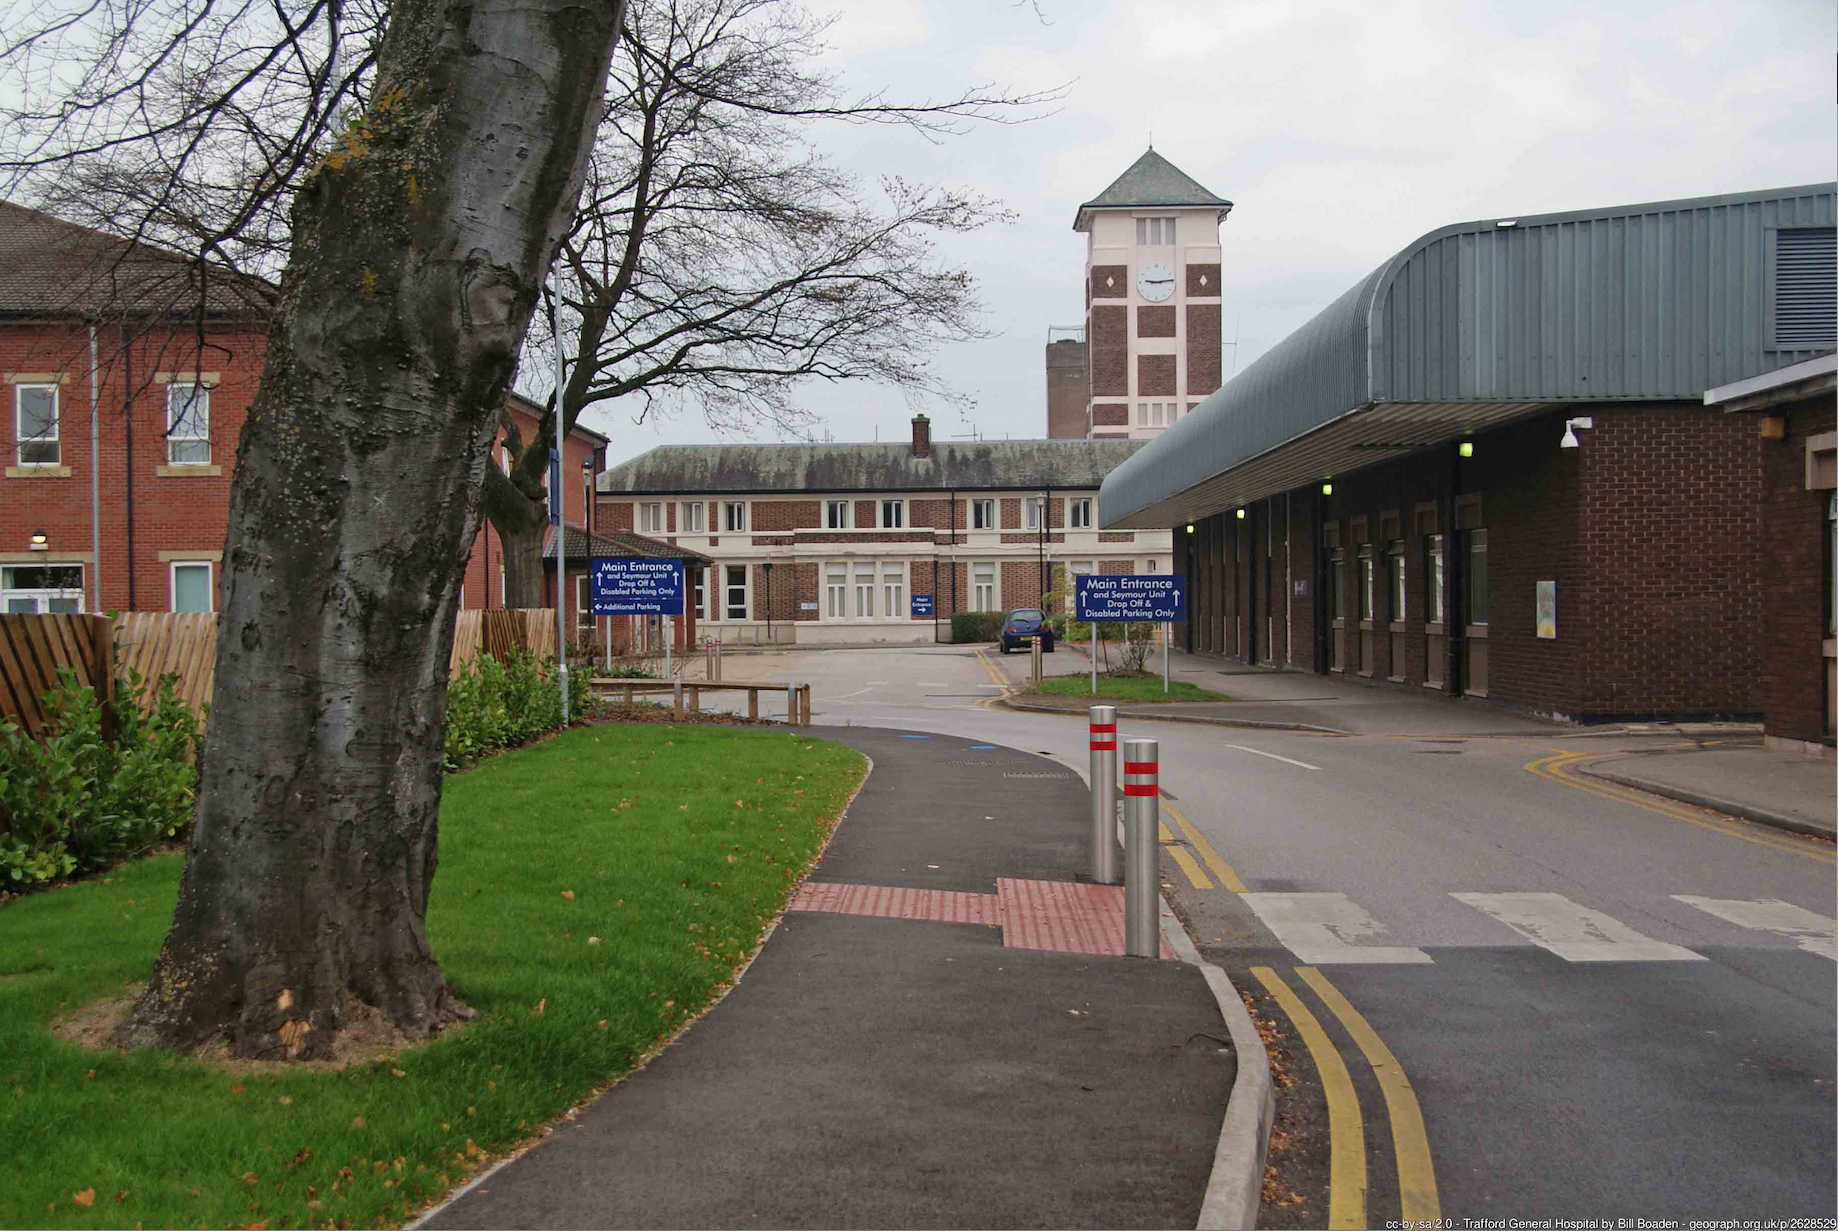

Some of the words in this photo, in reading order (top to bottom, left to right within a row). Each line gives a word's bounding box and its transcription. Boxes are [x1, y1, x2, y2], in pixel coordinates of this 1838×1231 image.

[602, 563, 627, 571] Main
[630, 562, 673, 571] Entrance
[1086, 578, 1116, 589] Main
[1121, 578, 1173, 589] Entrance
[1112, 590, 1146, 600] Seymour
[1149, 590, 1166, 598] Unit
[1107, 600, 1127, 608] Drop
[1130, 600, 1143, 608] Off
[1085, 609, 1120, 617] Disabled
[1123, 609, 1153, 618] Parking
[1155, 609, 1175, 618] Only
